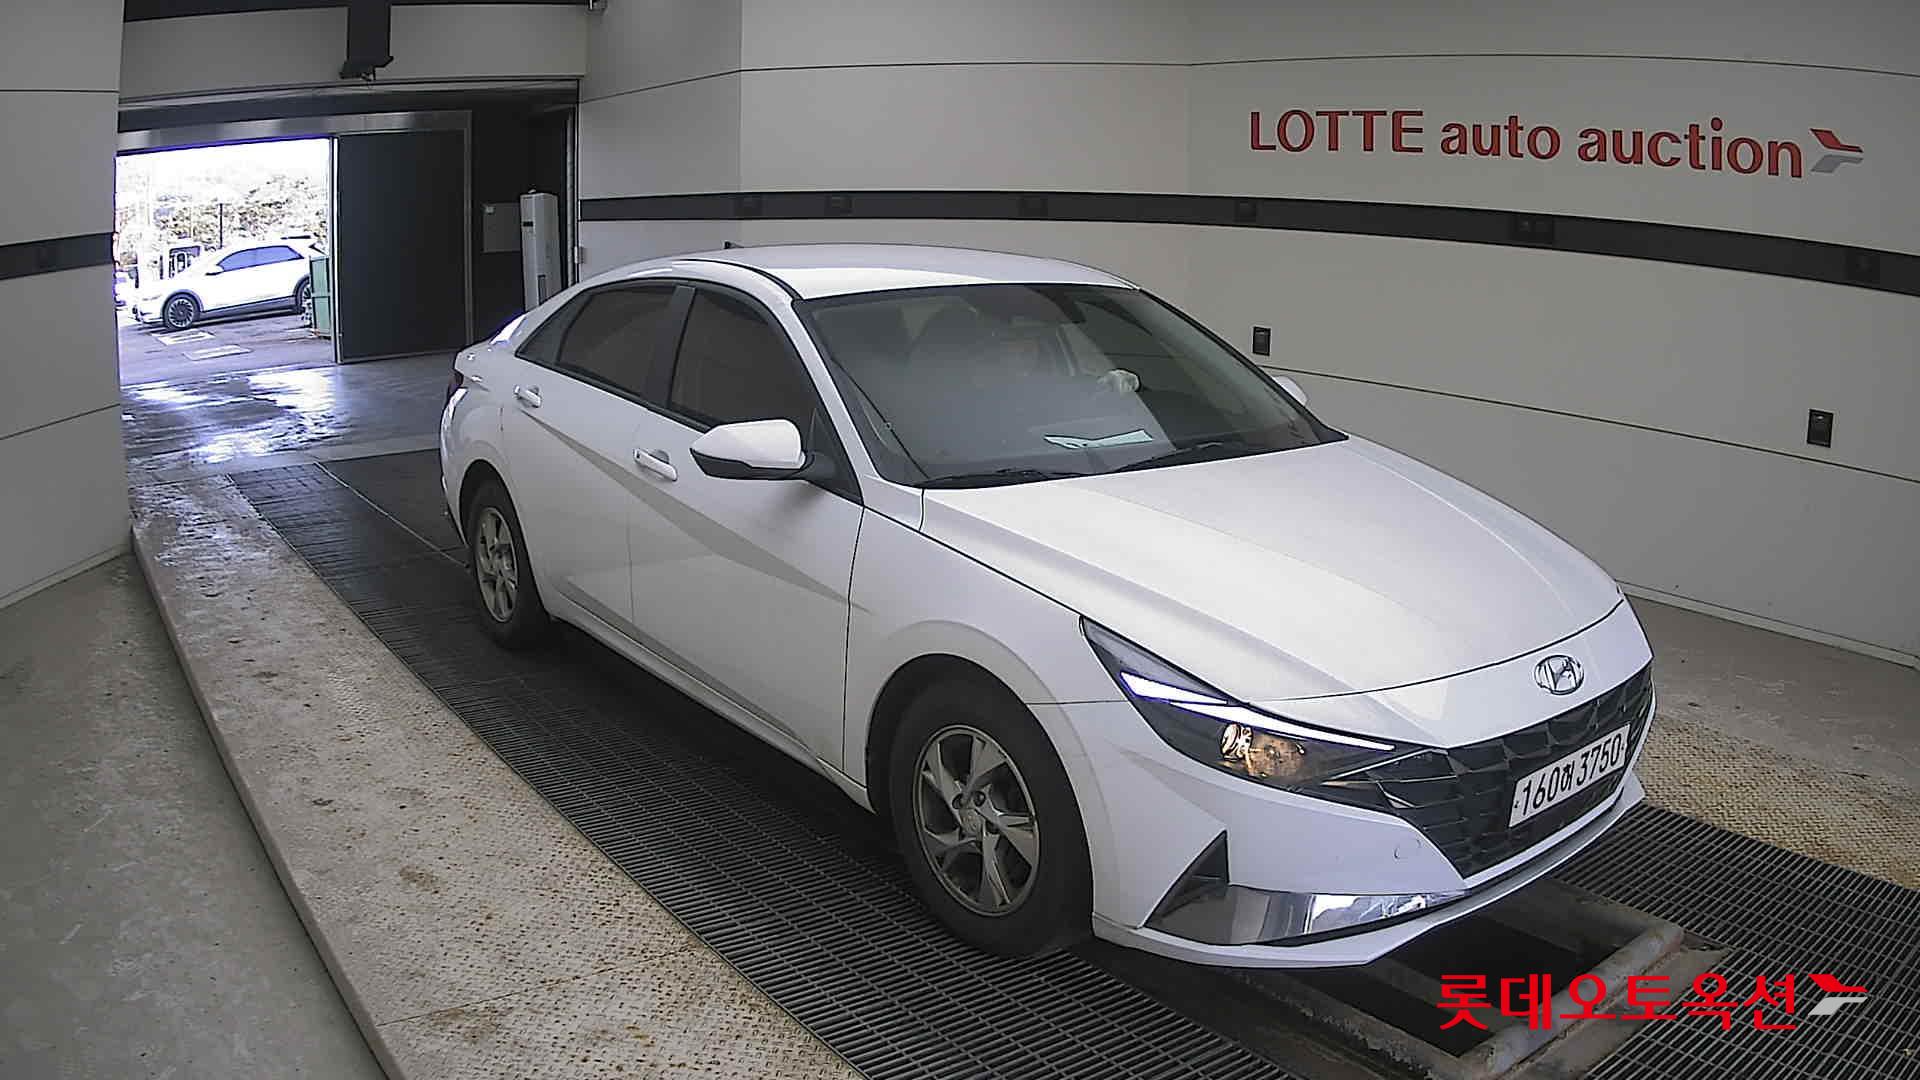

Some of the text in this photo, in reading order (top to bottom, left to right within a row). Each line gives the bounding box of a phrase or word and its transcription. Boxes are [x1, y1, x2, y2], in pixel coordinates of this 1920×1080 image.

[1250, 110, 1803, 178] LOTTE auto auction
[1522, 733, 1622, 816] 160허 3750
